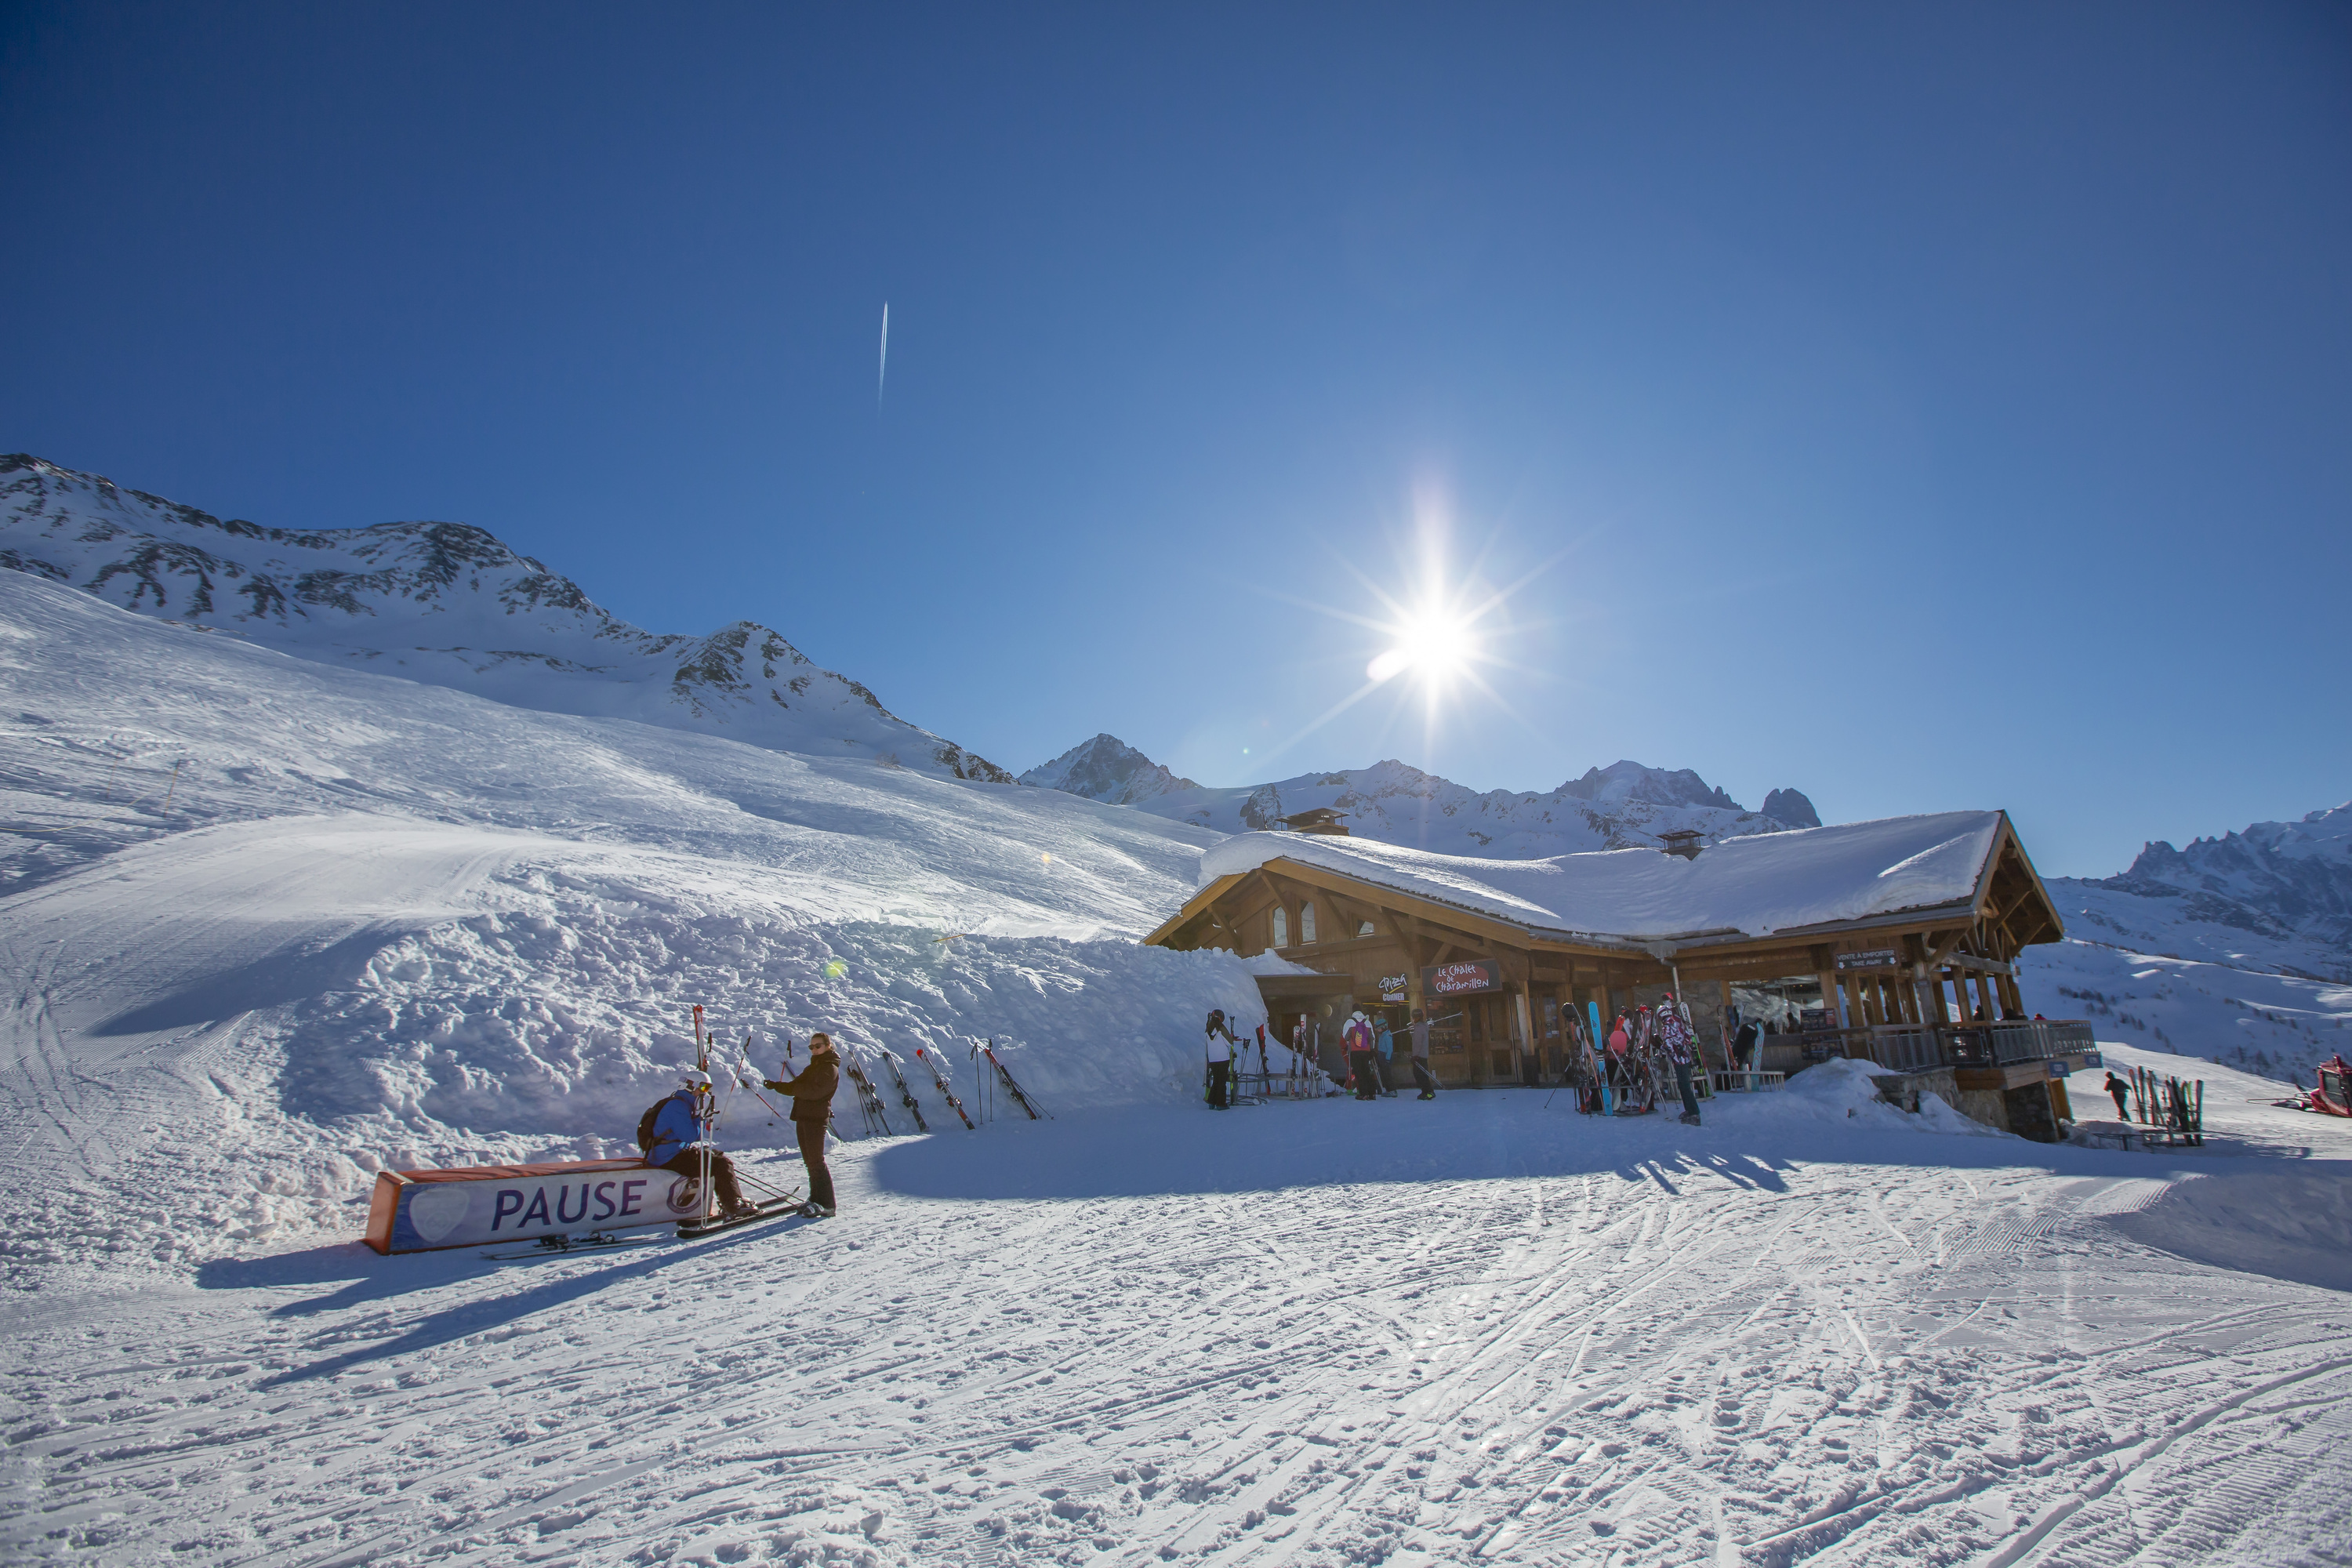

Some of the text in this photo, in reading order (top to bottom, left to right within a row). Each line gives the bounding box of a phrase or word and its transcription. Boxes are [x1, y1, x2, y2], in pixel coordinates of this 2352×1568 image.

[1863, 949, 1895, 958] EMPORTER
[1382, 993, 1405, 1001] CORNER
[491, 1179, 648, 1232] PAUSE
